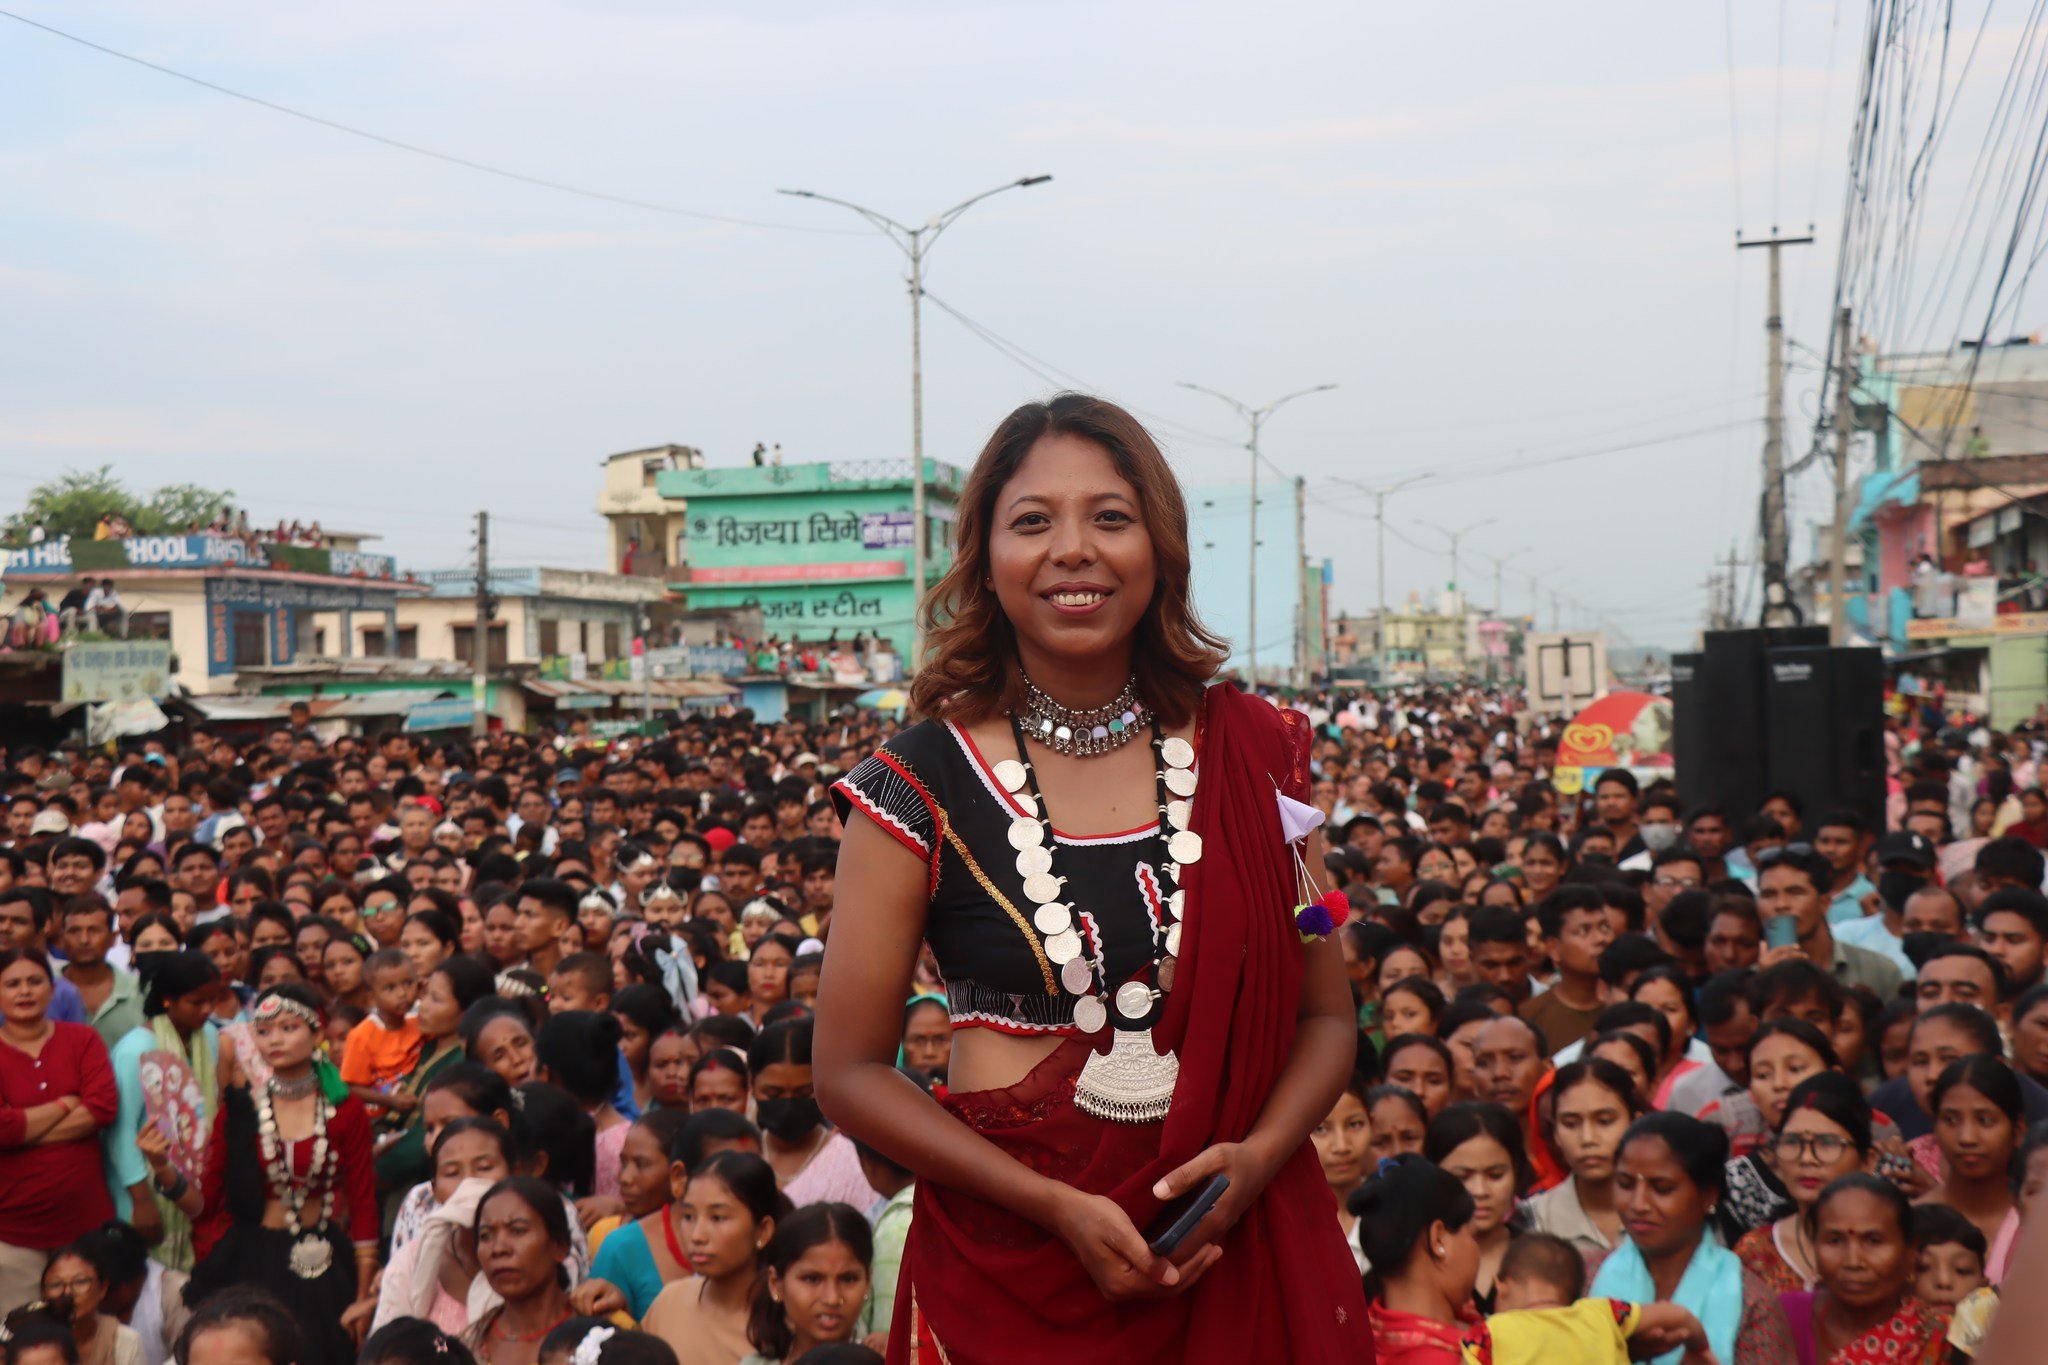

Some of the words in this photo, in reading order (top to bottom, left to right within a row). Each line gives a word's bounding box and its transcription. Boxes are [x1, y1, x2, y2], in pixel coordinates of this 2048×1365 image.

[717, 516, 799, 546] विजया
[808, 511, 861, 543] सिमे
[812, 591, 882, 617] स्टील
